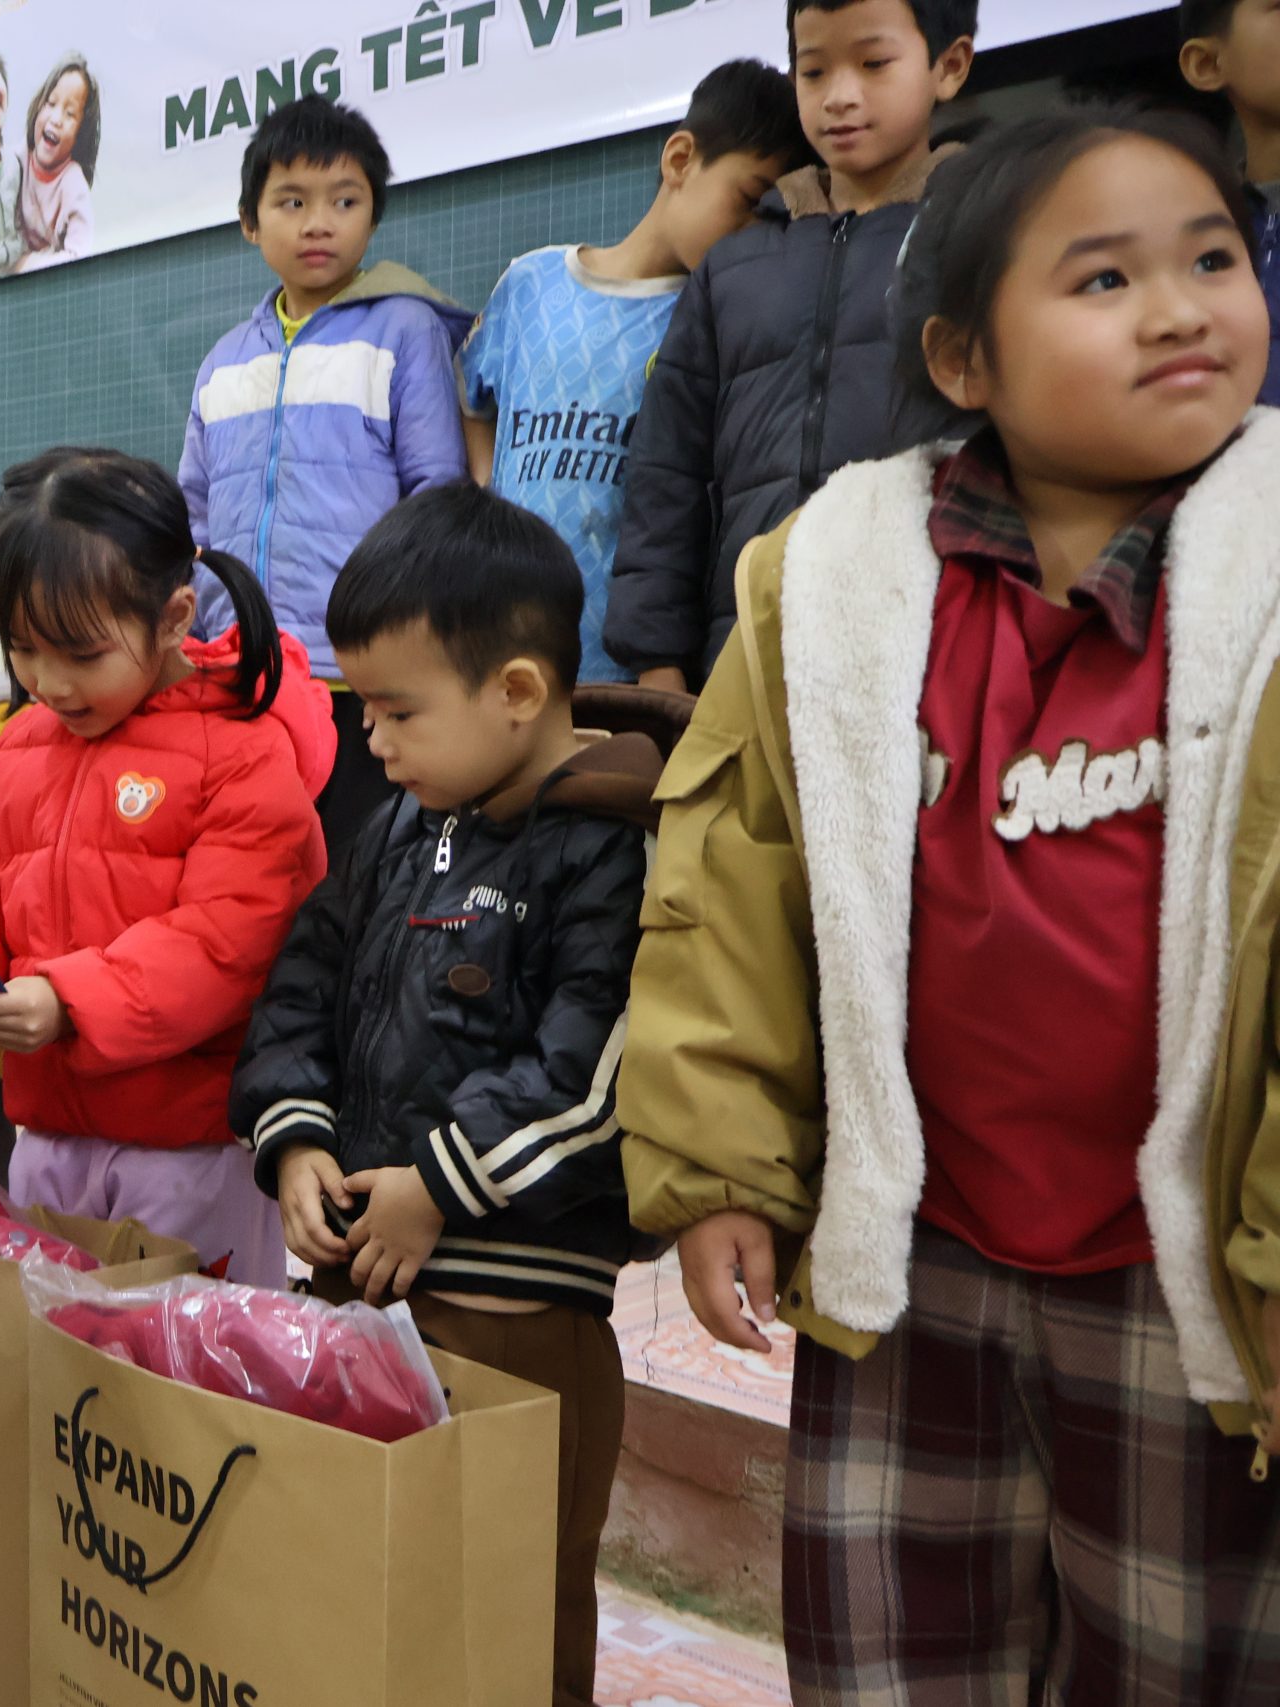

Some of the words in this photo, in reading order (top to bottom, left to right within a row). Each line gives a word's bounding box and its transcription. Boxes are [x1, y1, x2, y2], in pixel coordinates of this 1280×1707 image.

[165, 47, 341, 150] MANG
[361, 0, 496, 93] TẾT
[510, 400, 638, 449] Emira
[518, 448, 551, 485] FLY
[553, 448, 629, 486] BETTE
[54, 1412, 196, 1527] EXPAND
[56, 1493, 148, 1596] YOUR
